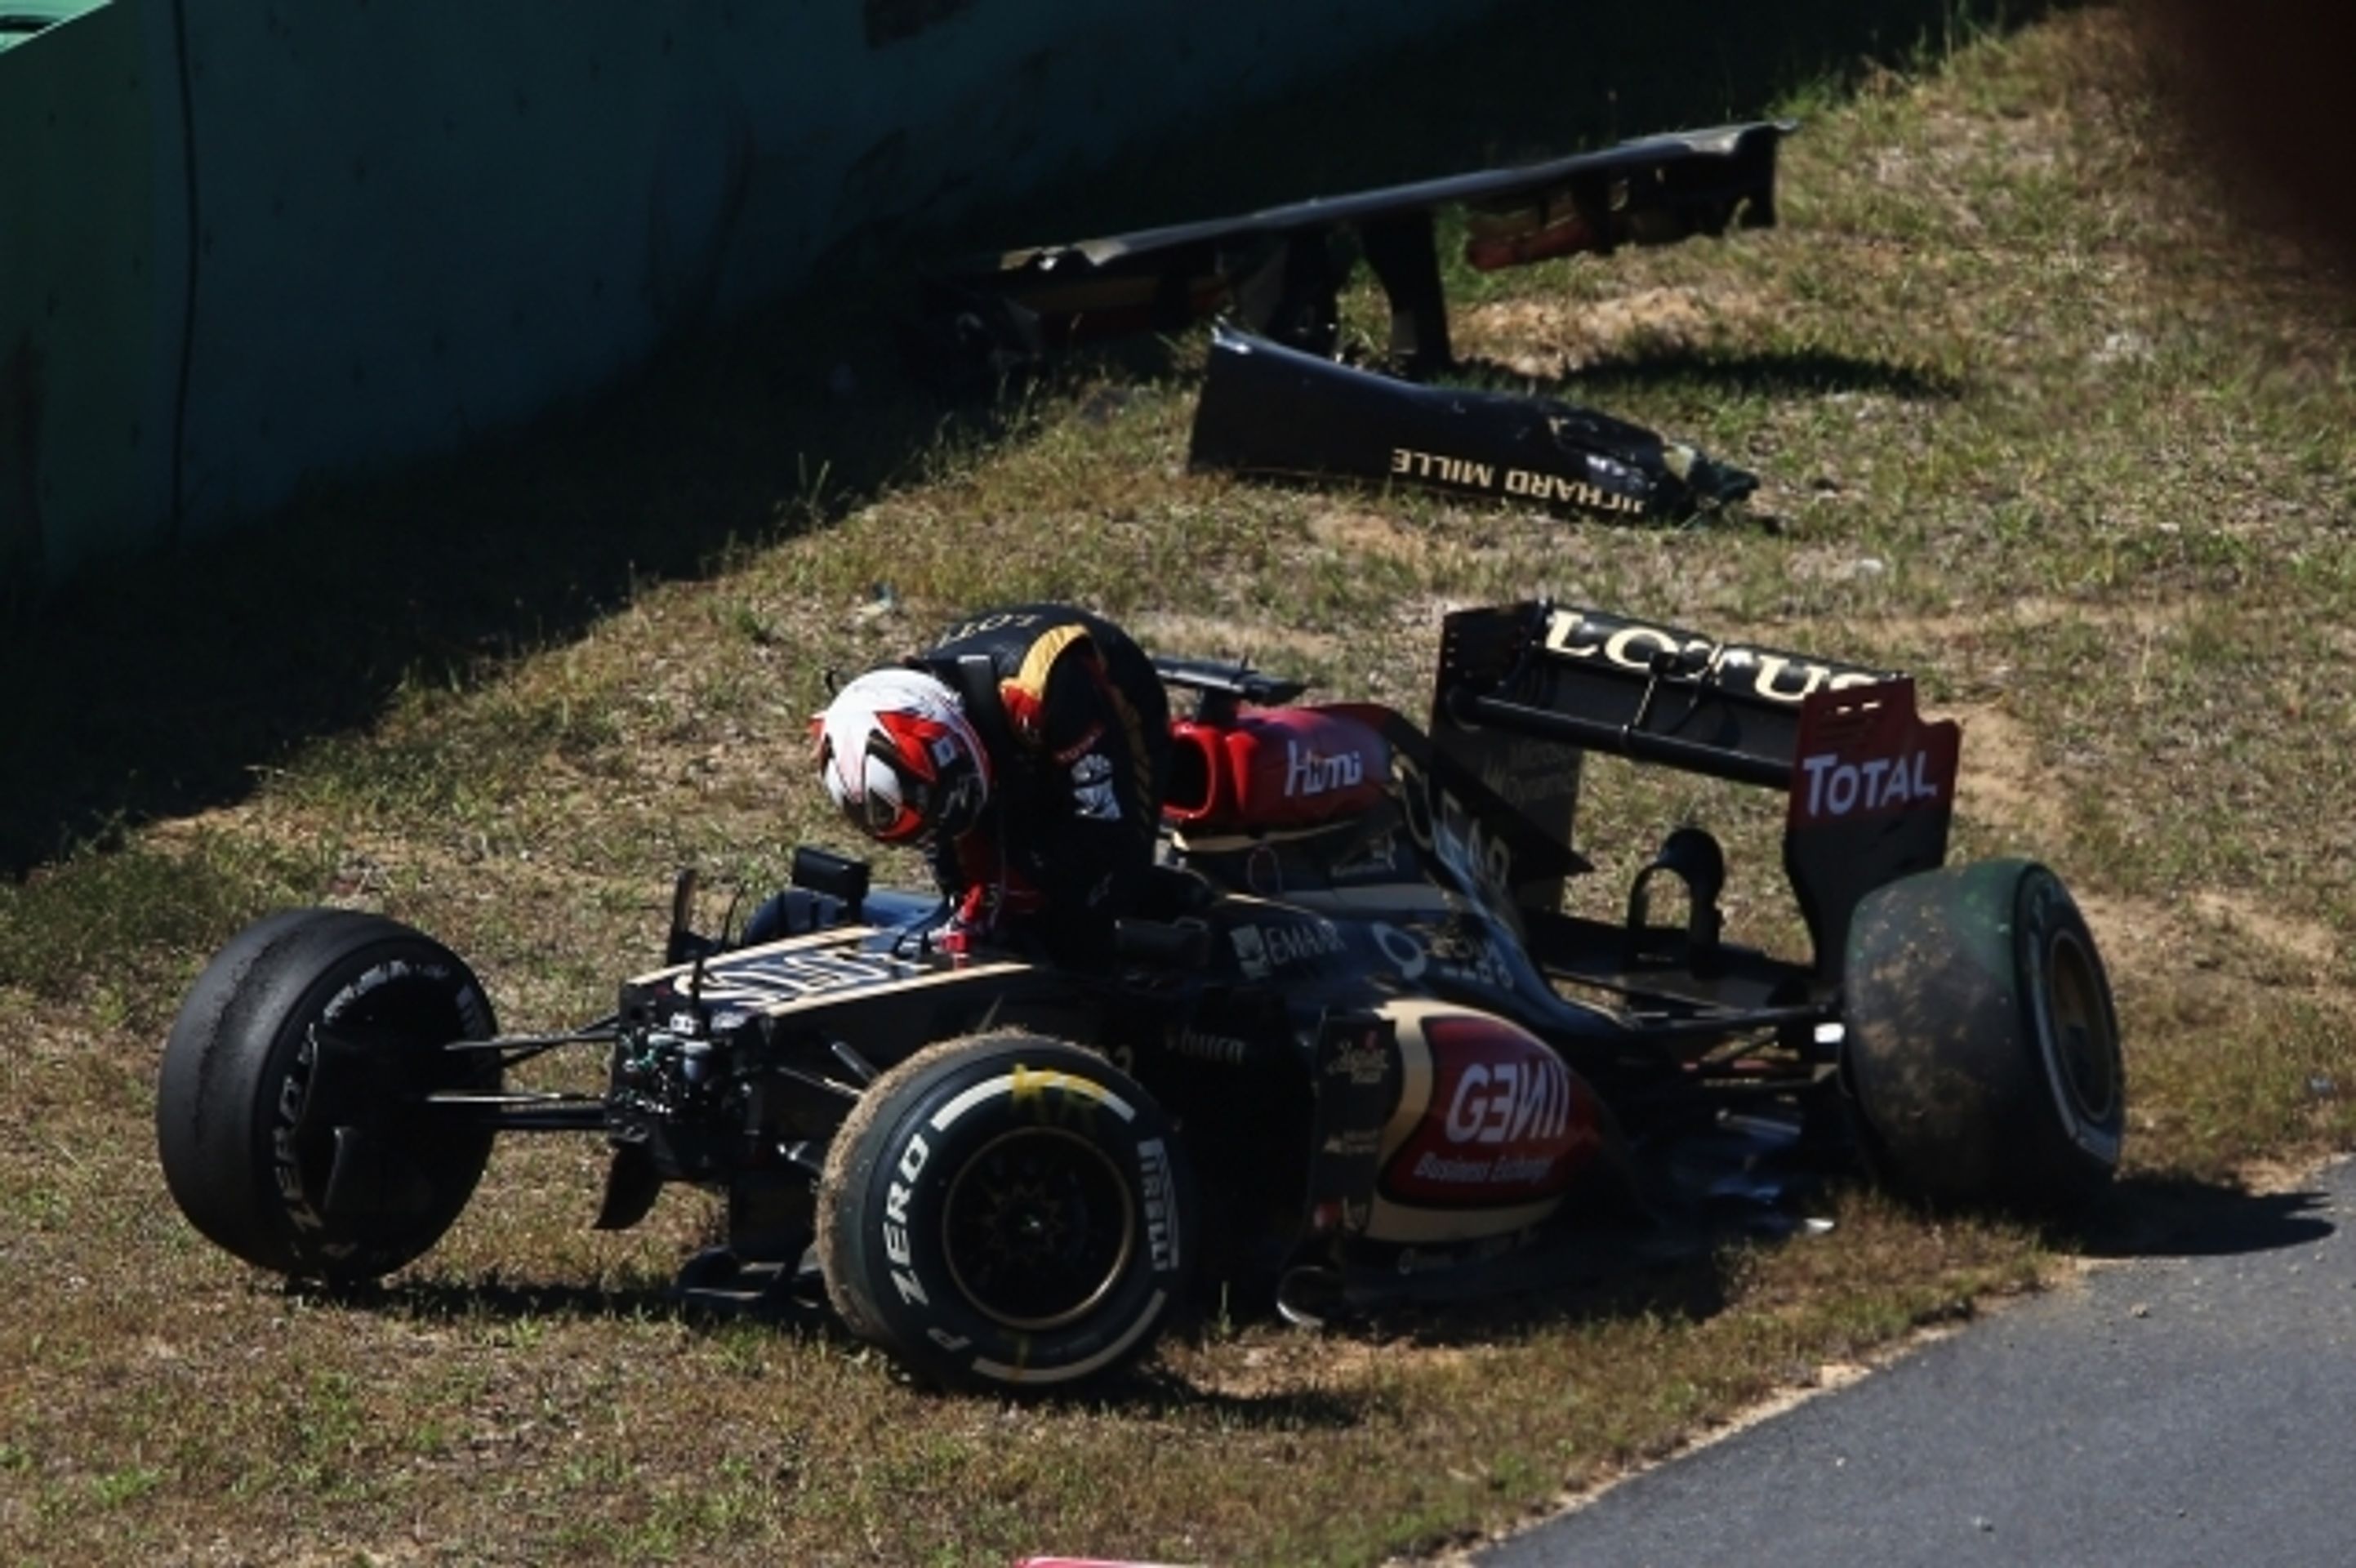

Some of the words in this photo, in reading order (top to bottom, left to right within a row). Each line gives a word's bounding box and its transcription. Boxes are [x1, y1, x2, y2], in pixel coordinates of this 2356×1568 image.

[1390, 448, 1494, 488] MILLE
[1803, 751, 1937, 815] TOTAL
[883, 1134, 930, 1305] ZERO
[1137, 1138, 1179, 1272] PIRELLI
